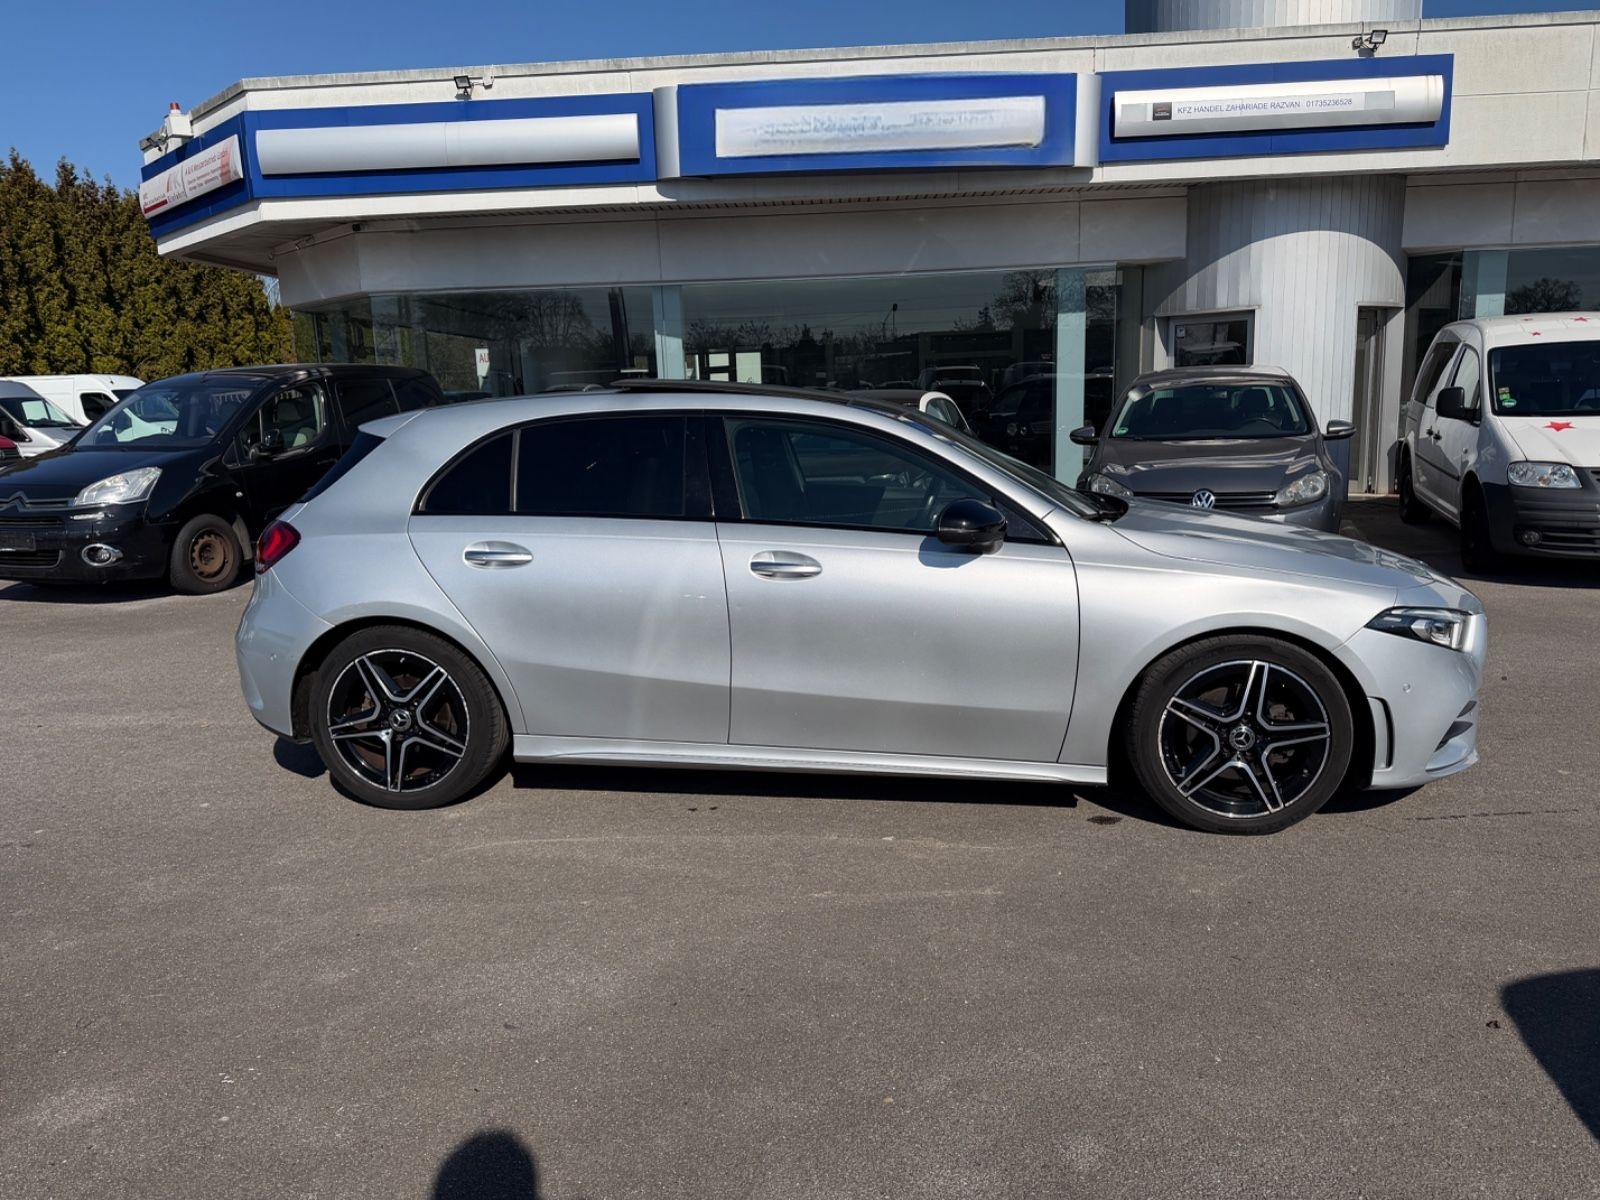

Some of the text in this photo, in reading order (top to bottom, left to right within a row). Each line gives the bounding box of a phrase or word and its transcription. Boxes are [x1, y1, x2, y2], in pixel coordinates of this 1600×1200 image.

[1177, 106, 1192, 114] KFZ
[1194, 105, 1224, 113] HANDEL
[1225, 102, 1269, 112] ZAHARIADE
[1270, 101, 1300, 110] RAZVAN
